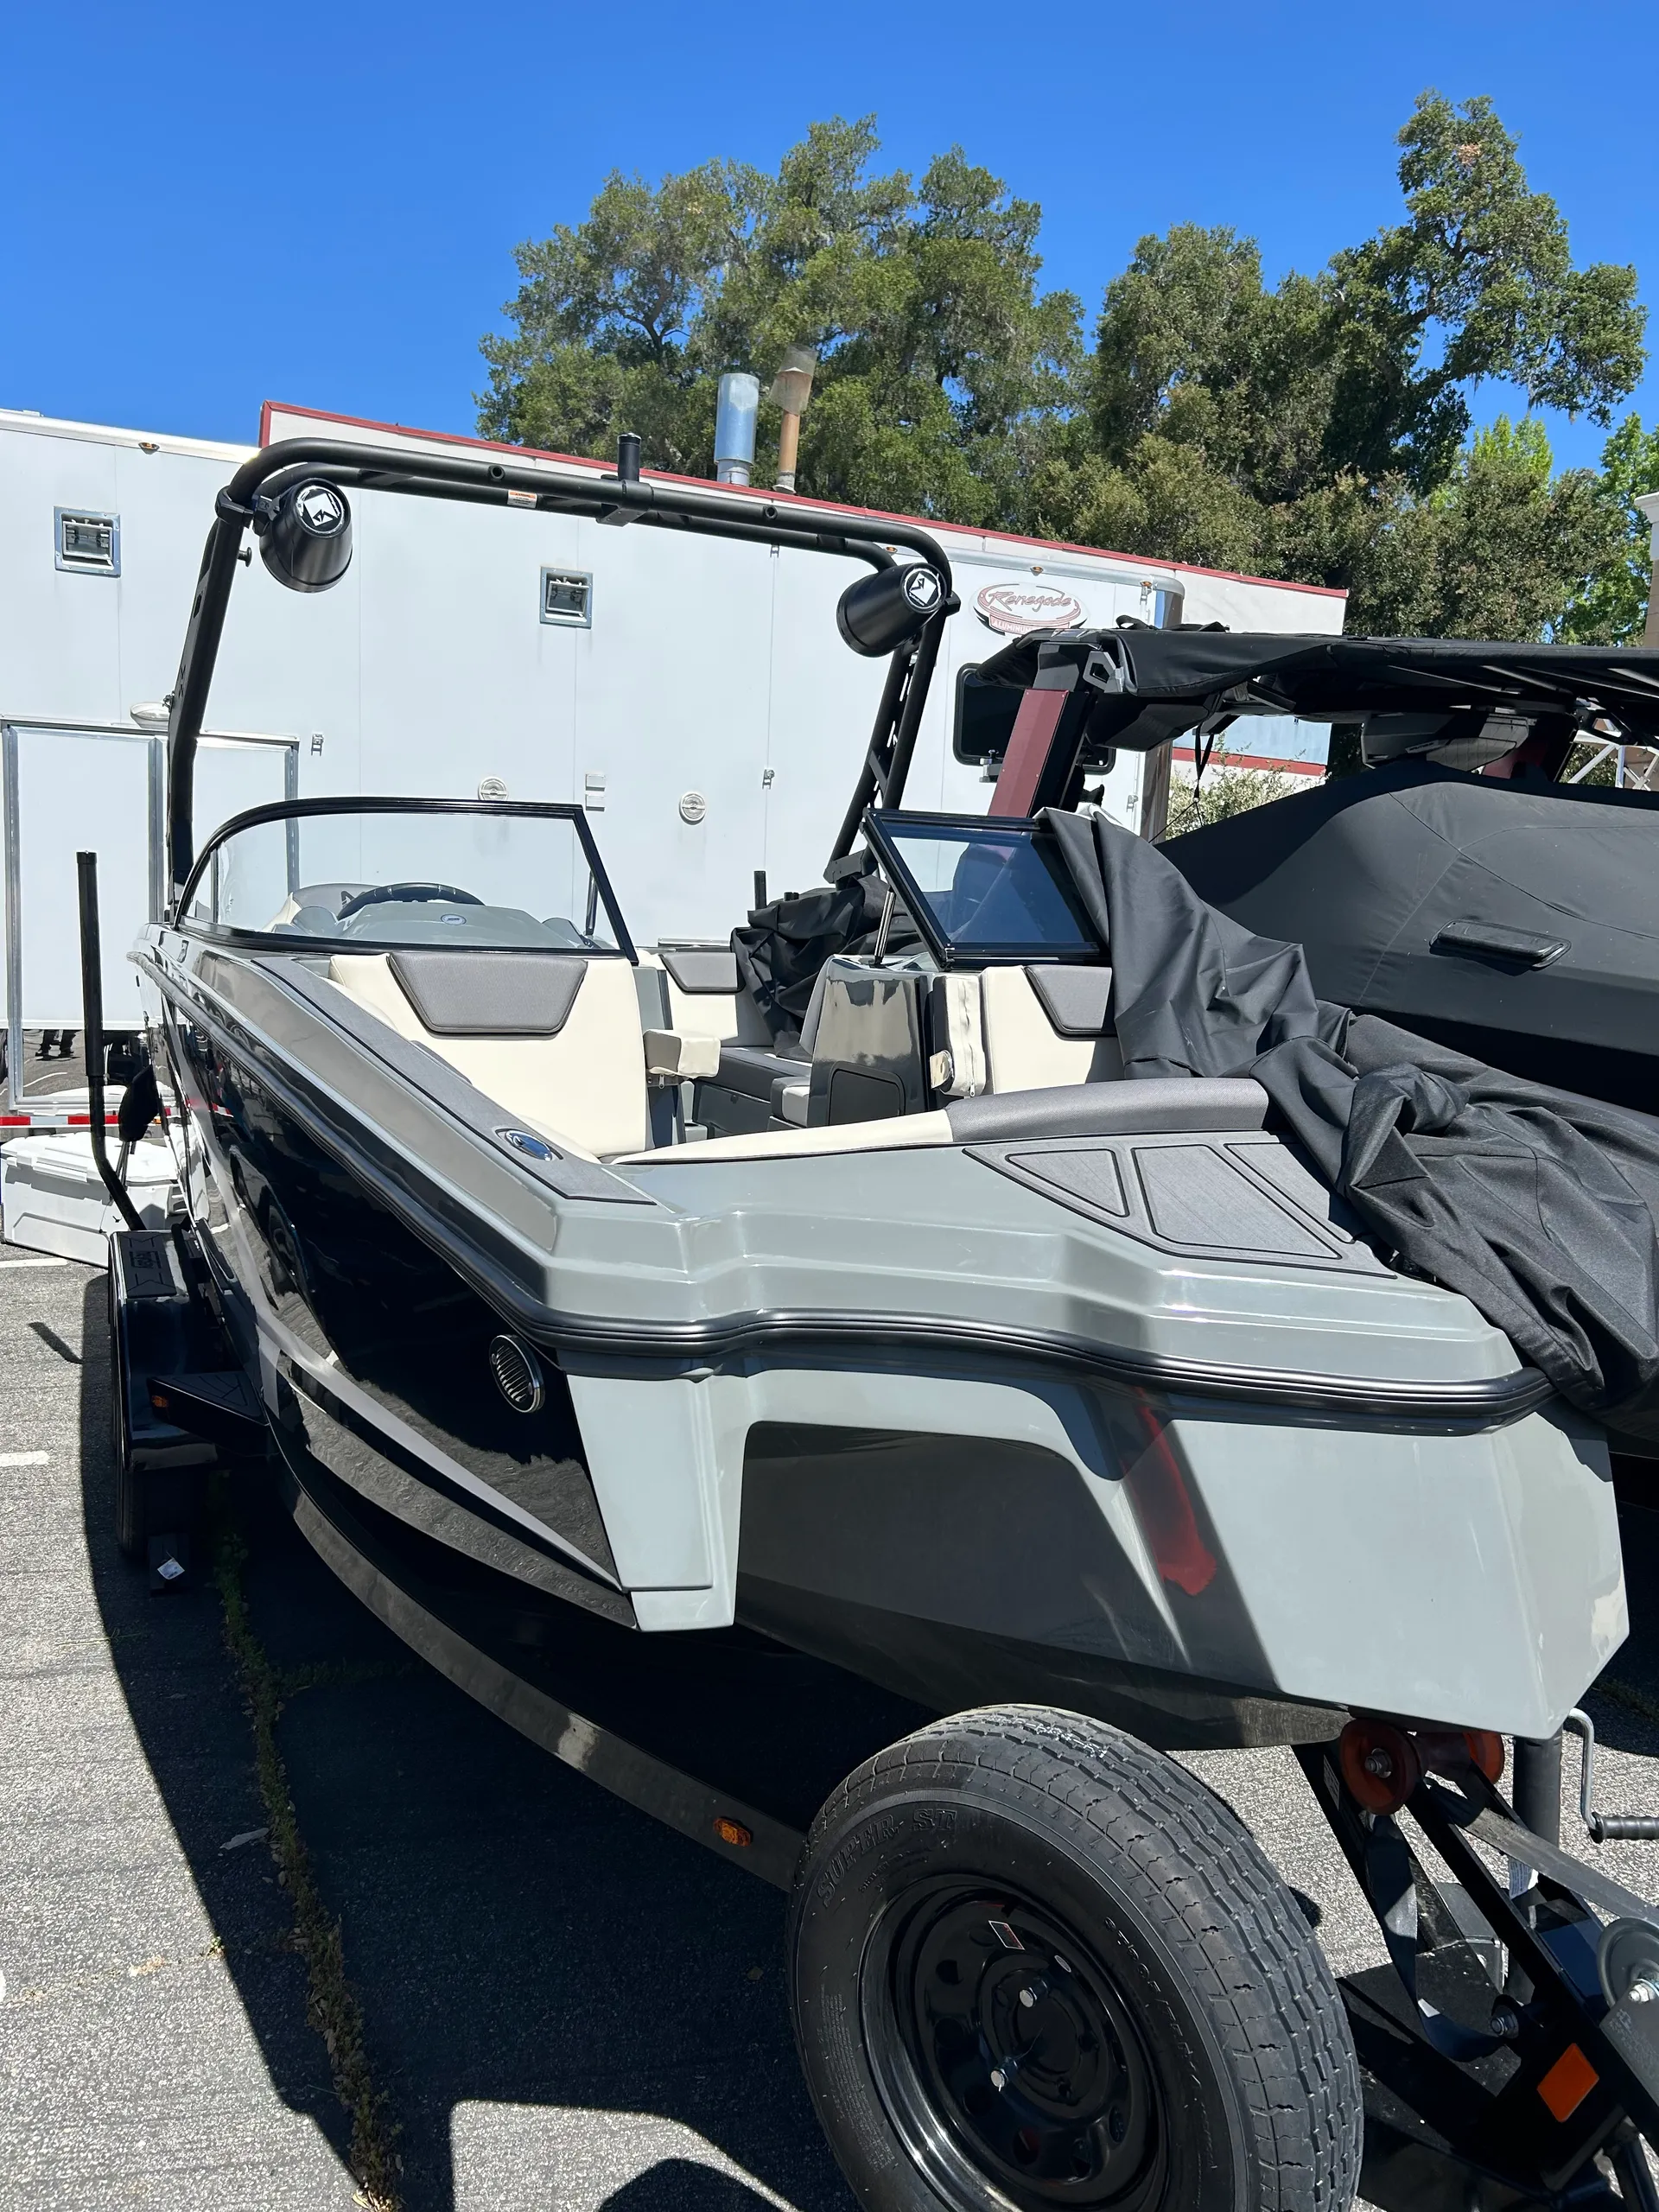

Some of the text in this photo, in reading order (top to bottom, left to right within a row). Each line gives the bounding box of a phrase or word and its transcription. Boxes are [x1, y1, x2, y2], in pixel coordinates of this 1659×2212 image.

[988, 591, 1071, 612] Renegade
[817, 1815, 899, 1908] SUPER
[913, 1808, 957, 1832] ST
